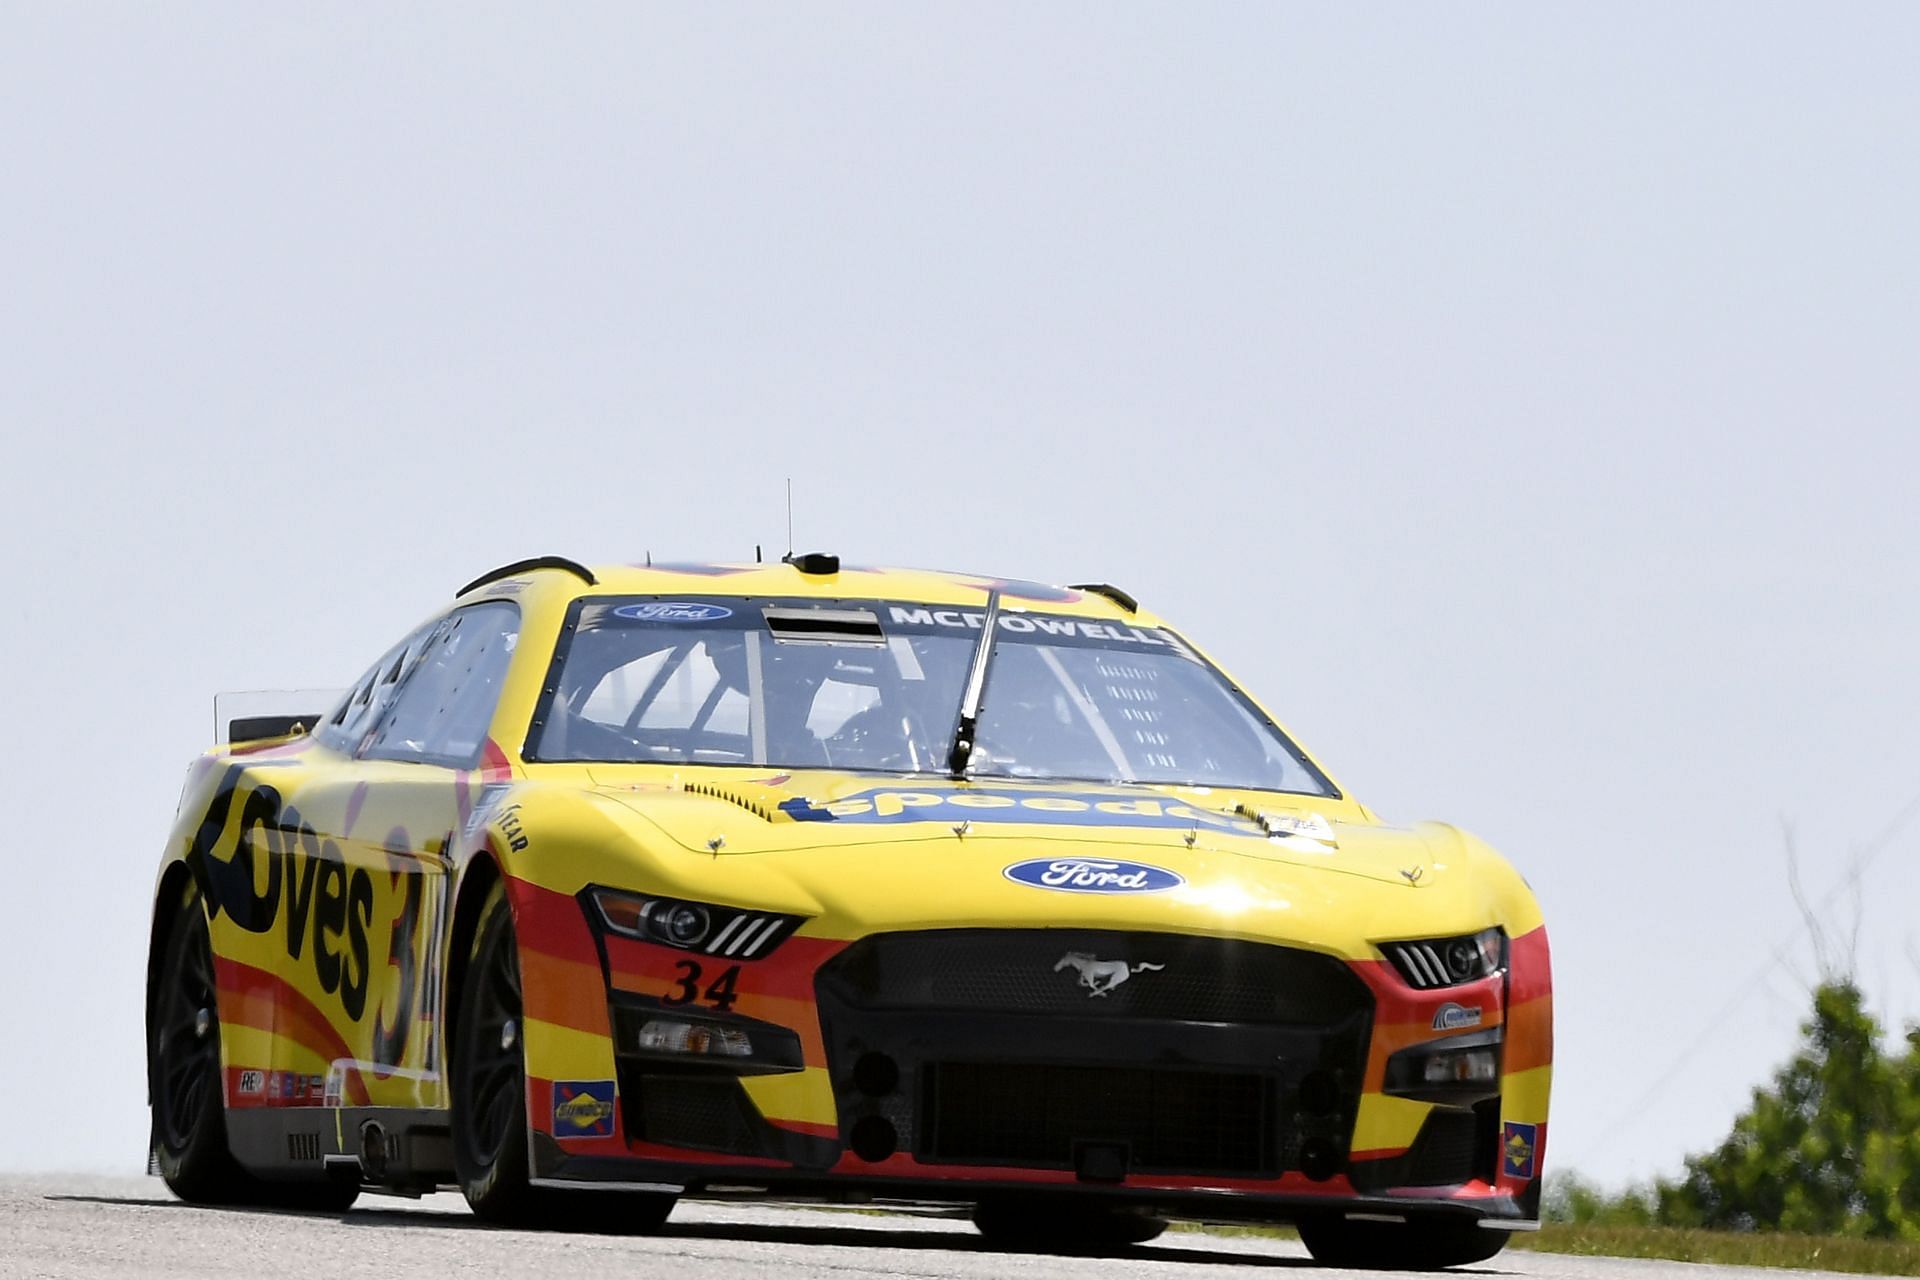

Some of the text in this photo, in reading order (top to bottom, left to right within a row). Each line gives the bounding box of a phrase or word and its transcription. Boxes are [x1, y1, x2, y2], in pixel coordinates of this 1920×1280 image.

[636, 603, 711, 619] Ford
[888, 606, 1166, 646] MCDOWELL
[1040, 859, 1149, 889] Ford
[661, 959, 742, 1012] 34
